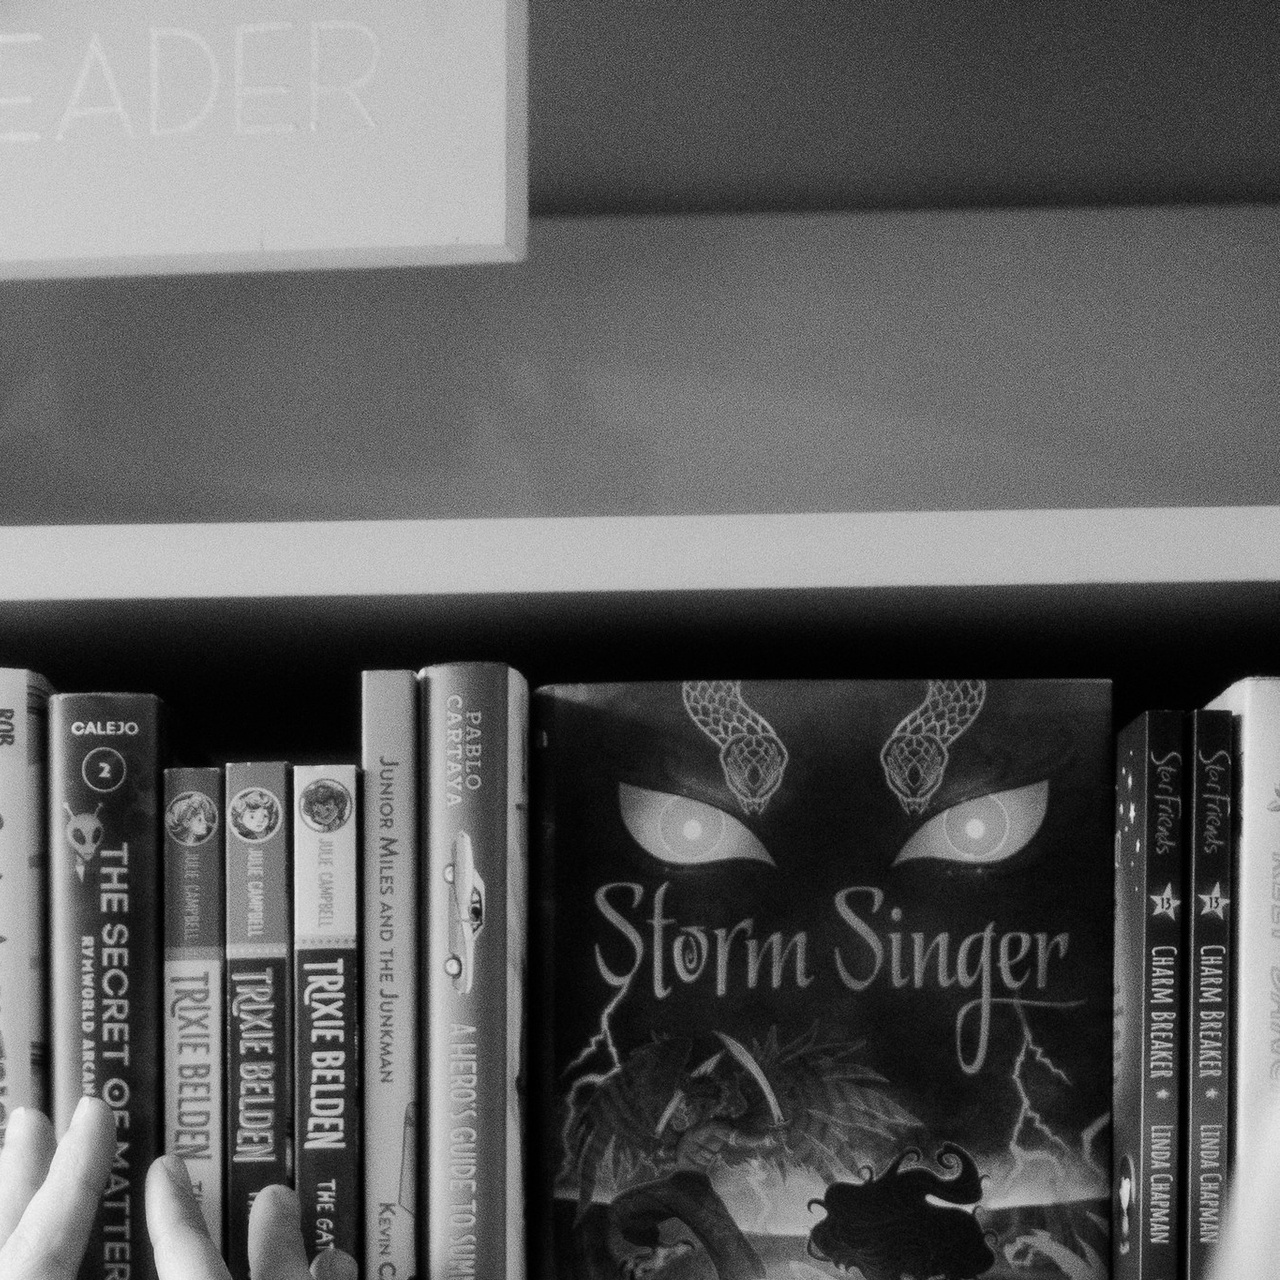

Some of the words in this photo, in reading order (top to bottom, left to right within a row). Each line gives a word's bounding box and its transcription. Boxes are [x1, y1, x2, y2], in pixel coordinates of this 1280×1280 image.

[71, 721, 139, 735] CALEJO
[446, 694, 463, 806] CARTAYA
[466, 710, 482, 790] PABLO
[99, 762, 111, 778] 2
[100, 842, 129, 913] THE
[248, 879, 265, 937] CAMPBELL
[379, 902, 394, 941] AND
[102, 923, 130, 1066] SECRET
[303, 958, 346, 1043] TRIXIE
[379, 949, 393, 982] THE
[595, 882, 814, 1000] Storm
[835, 886, 1084, 1073] Singer
[170, 971, 210, 1055] TRIXIE
[231, 967, 275, 1054] TRIXIE
[1151, 1011, 1176, 1079] BREAKER
[1199, 1010, 1225, 1079] BREAKER
[174, 1063, 213, 1160] BELDEN
[232, 1060, 276, 1162] BELDEN
[304, 1049, 346, 1150] BELDEN
[317, 1178, 336, 1213] THE
[451, 1127, 477, 1196] GUIDE
